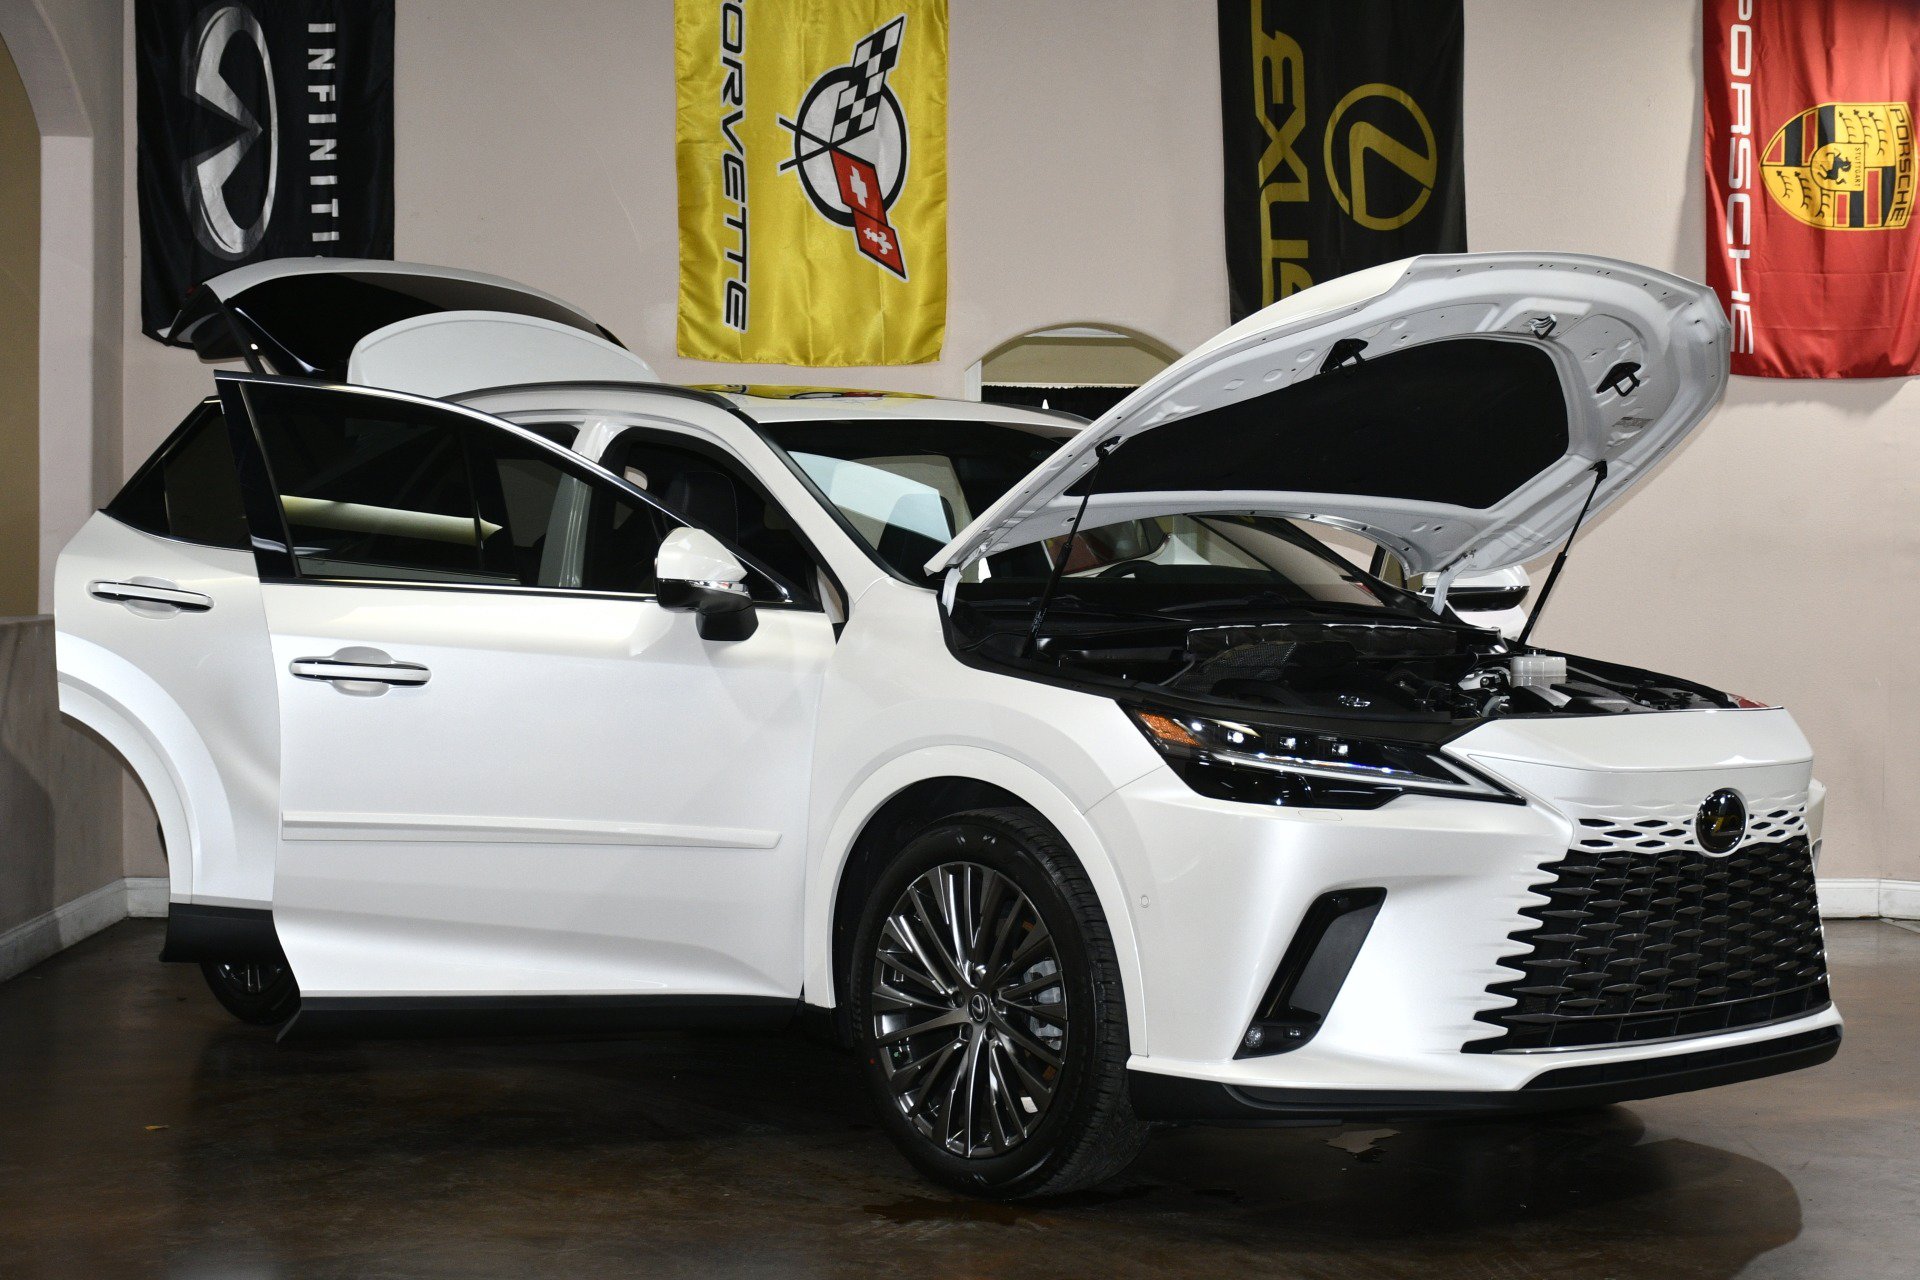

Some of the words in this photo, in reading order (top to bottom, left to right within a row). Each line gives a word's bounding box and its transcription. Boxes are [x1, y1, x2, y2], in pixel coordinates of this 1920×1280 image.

[308, 23, 340, 242] INFINITI
[721, 0, 748, 331] ORVETTE
[1889, 108, 1911, 221] PORSCHE
